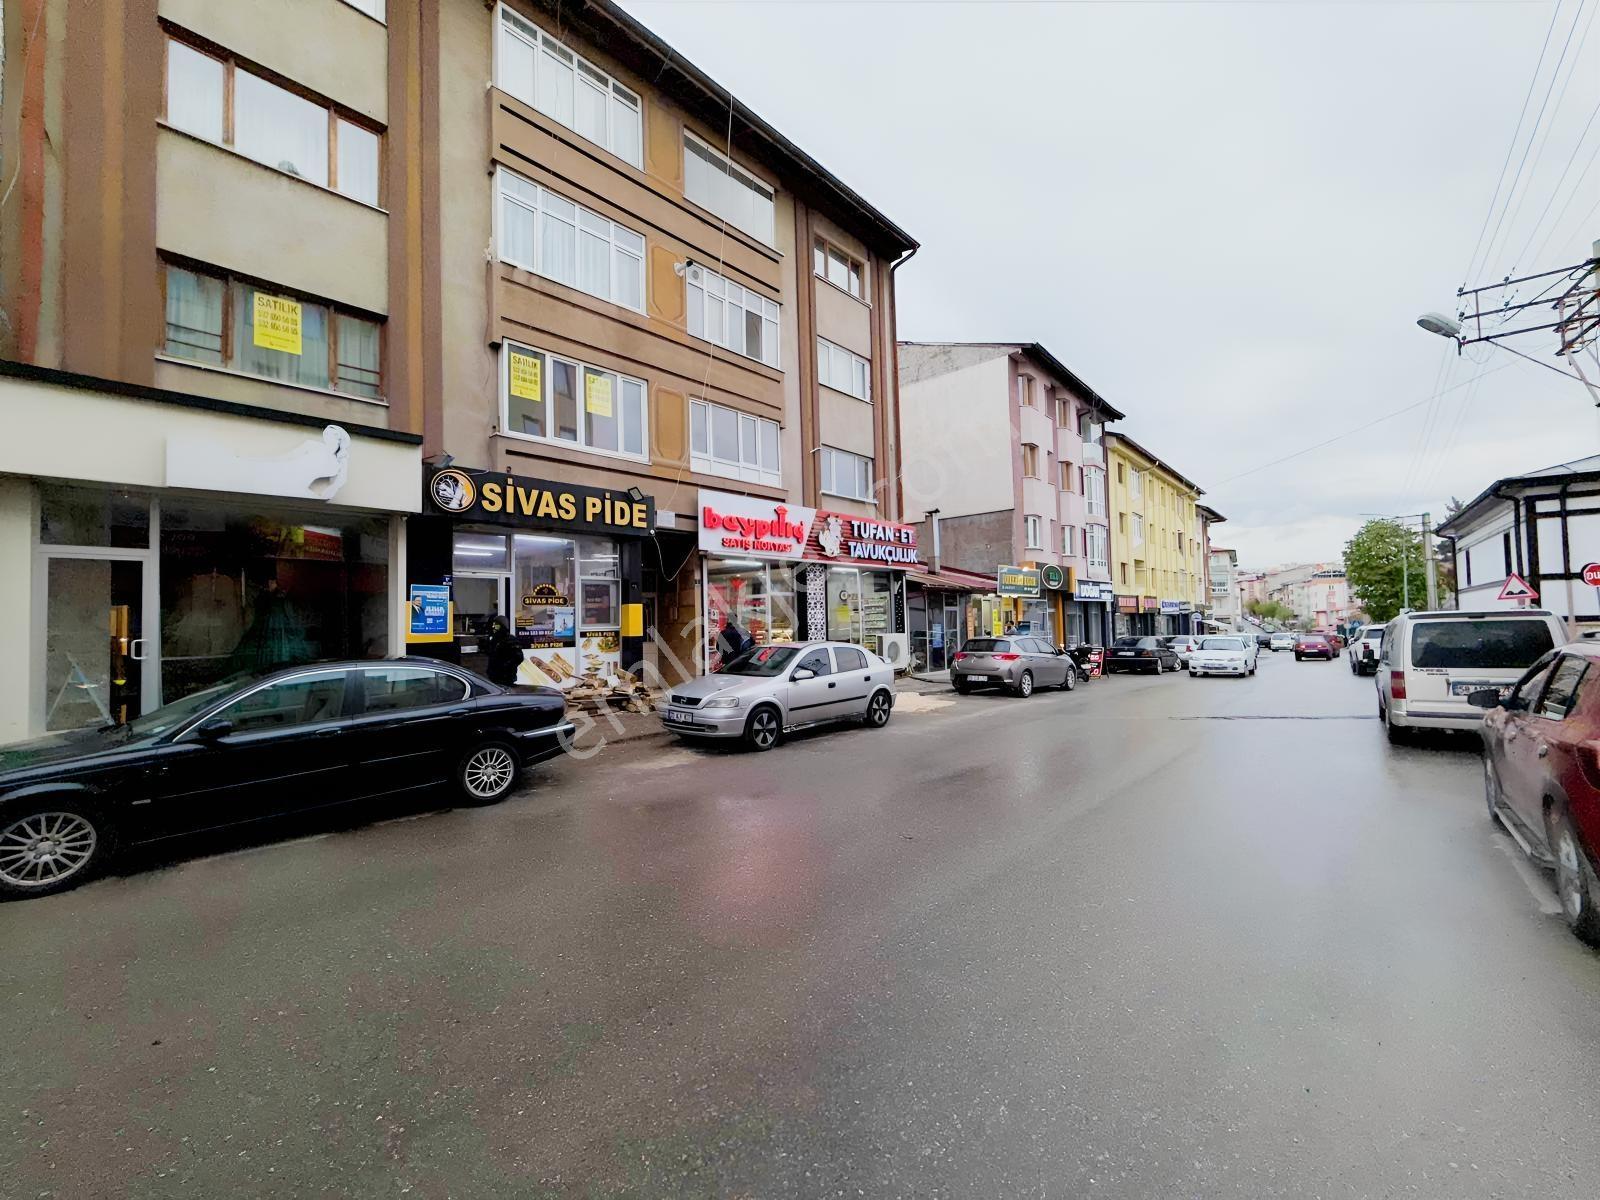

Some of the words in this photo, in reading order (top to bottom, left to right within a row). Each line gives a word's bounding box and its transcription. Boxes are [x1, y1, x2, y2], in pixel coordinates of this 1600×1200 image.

[257, 296, 298, 316] SATILIK
[481, 477, 577, 521] SİVAS
[585, 492, 648, 529] PİDE
[721, 537, 751, 550] SATIŞ
[848, 541, 918, 565] TAVUKÇULUK
[524, 596, 546, 604] SİVAS
[548, 596, 565, 604] PİDE
